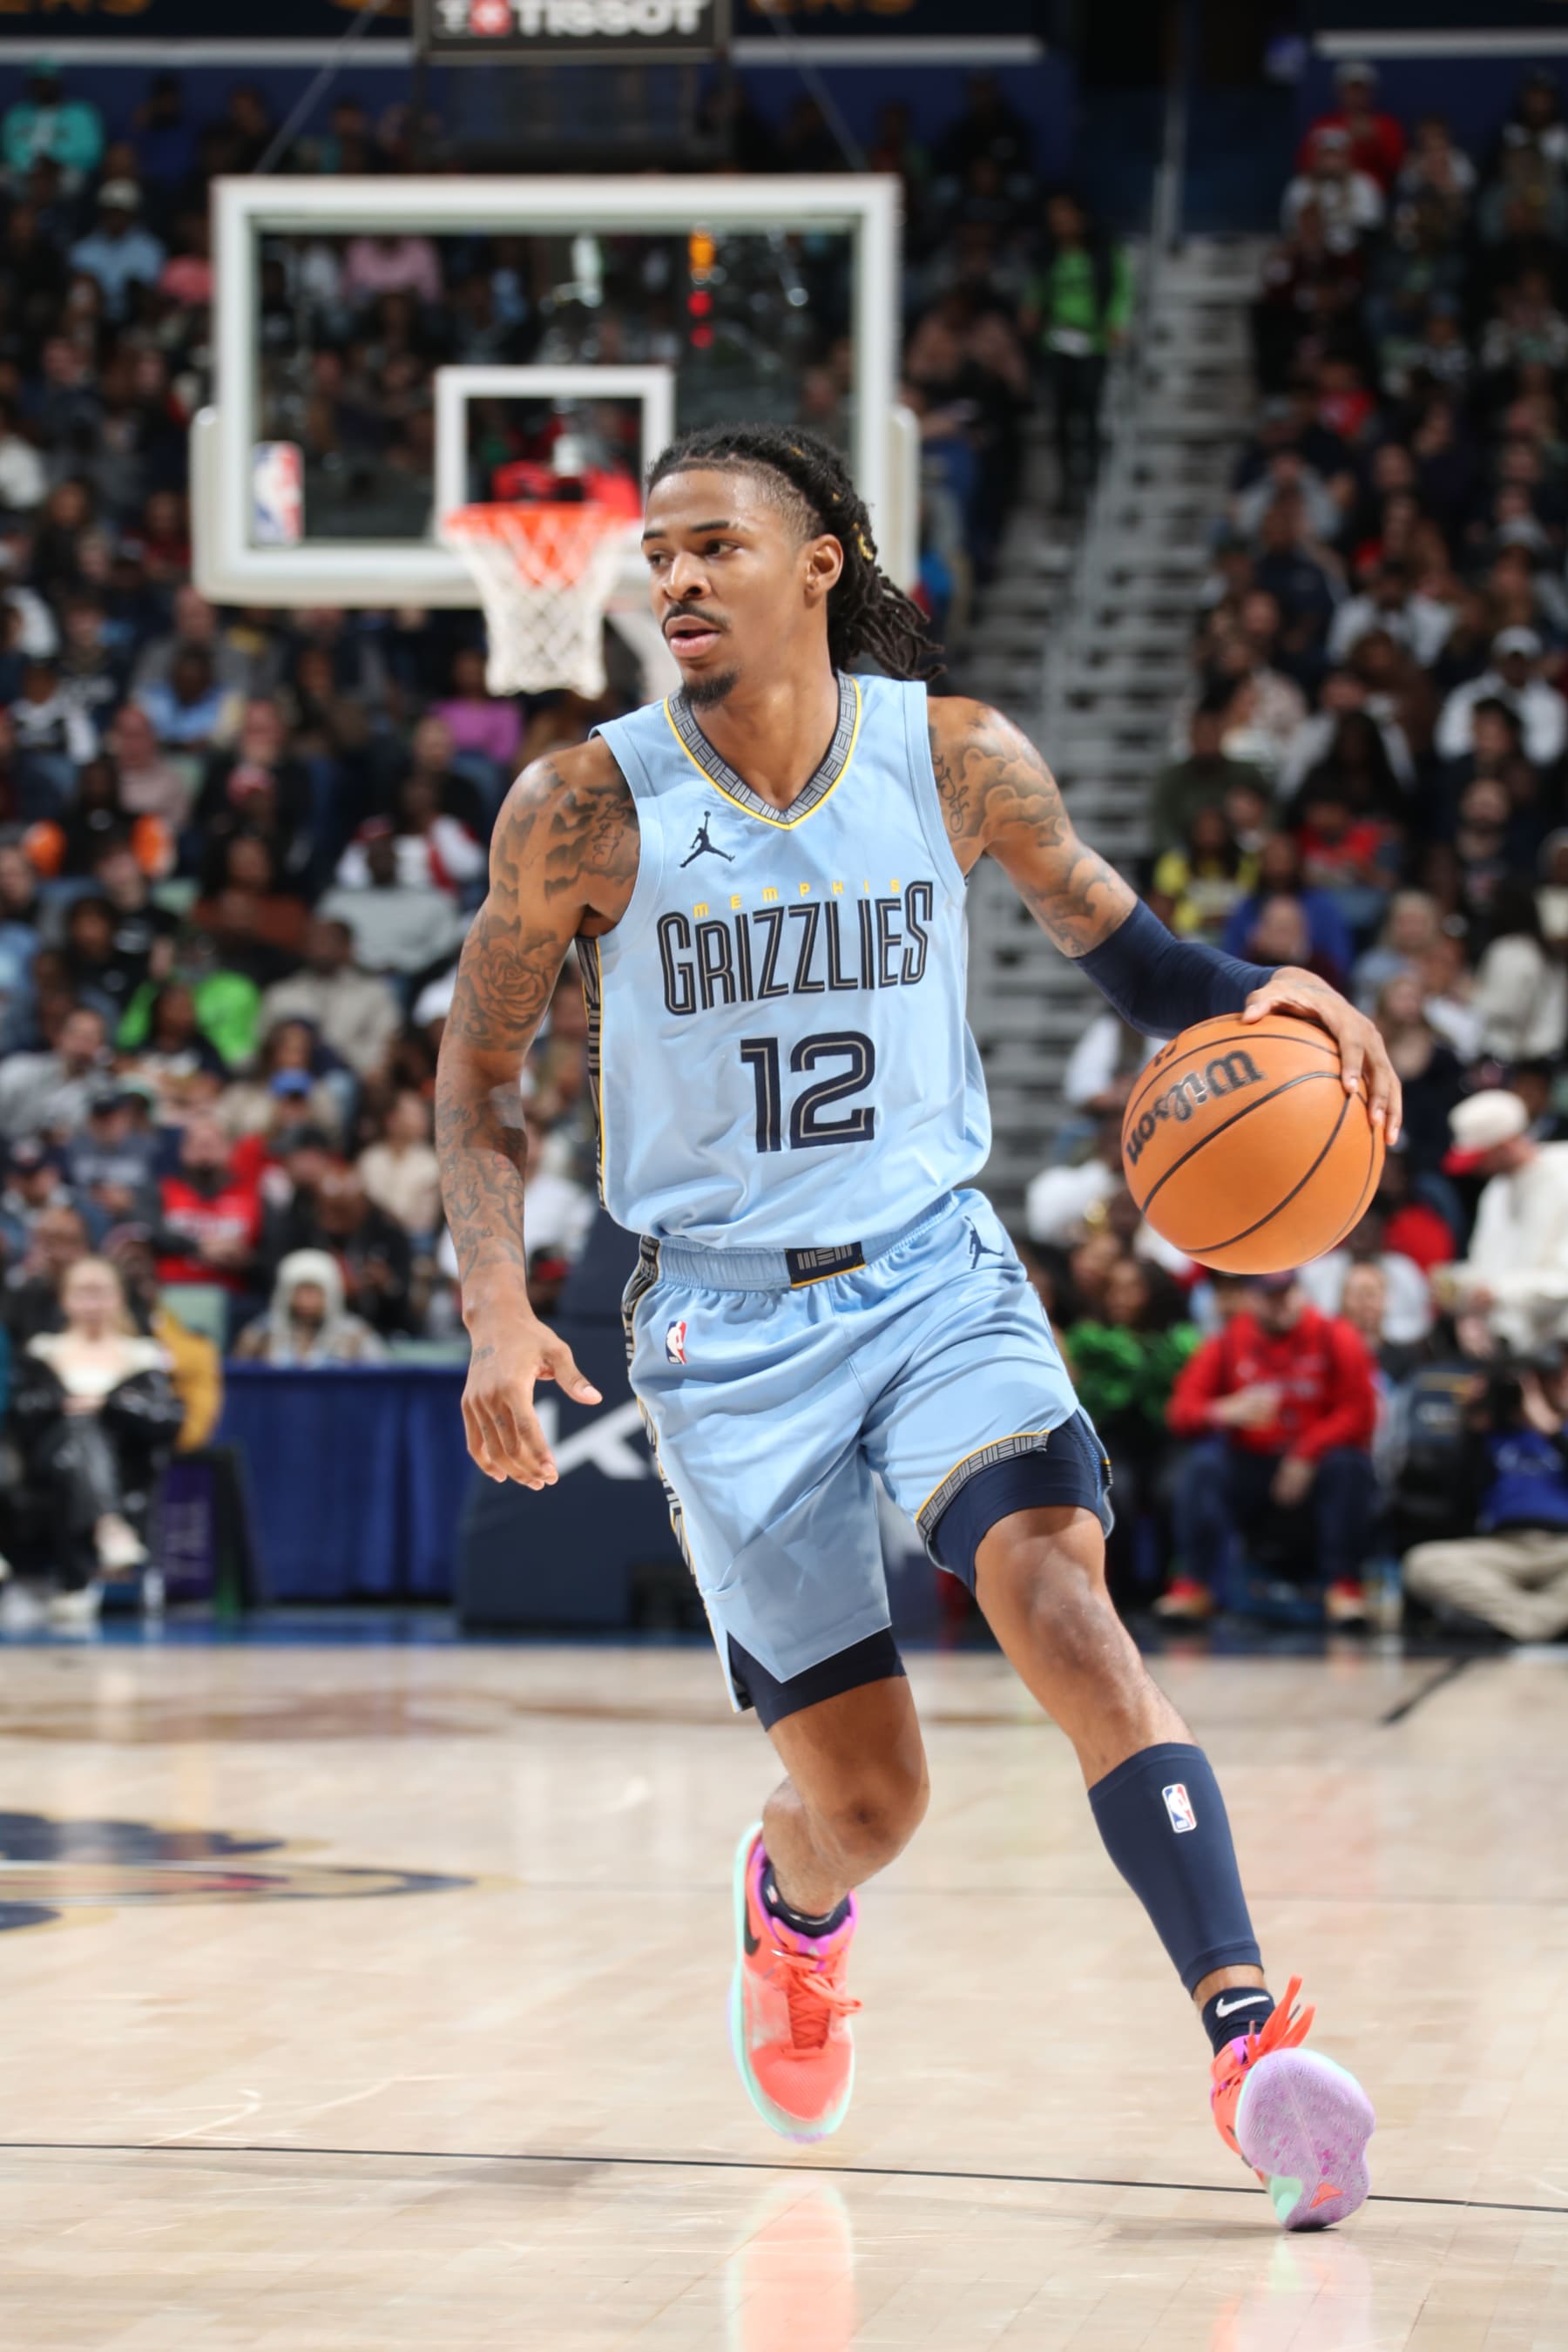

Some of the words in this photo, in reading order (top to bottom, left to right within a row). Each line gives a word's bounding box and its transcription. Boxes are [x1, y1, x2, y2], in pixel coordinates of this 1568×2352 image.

[512, 0, 710, 37] TISSOT
[657, 881, 933, 1016] GRIZZLIES
[693, 878, 901, 919] MEMPHIS
[740, 1031, 875, 1153] 12
[1126, 1050, 1267, 1166] Wilson
